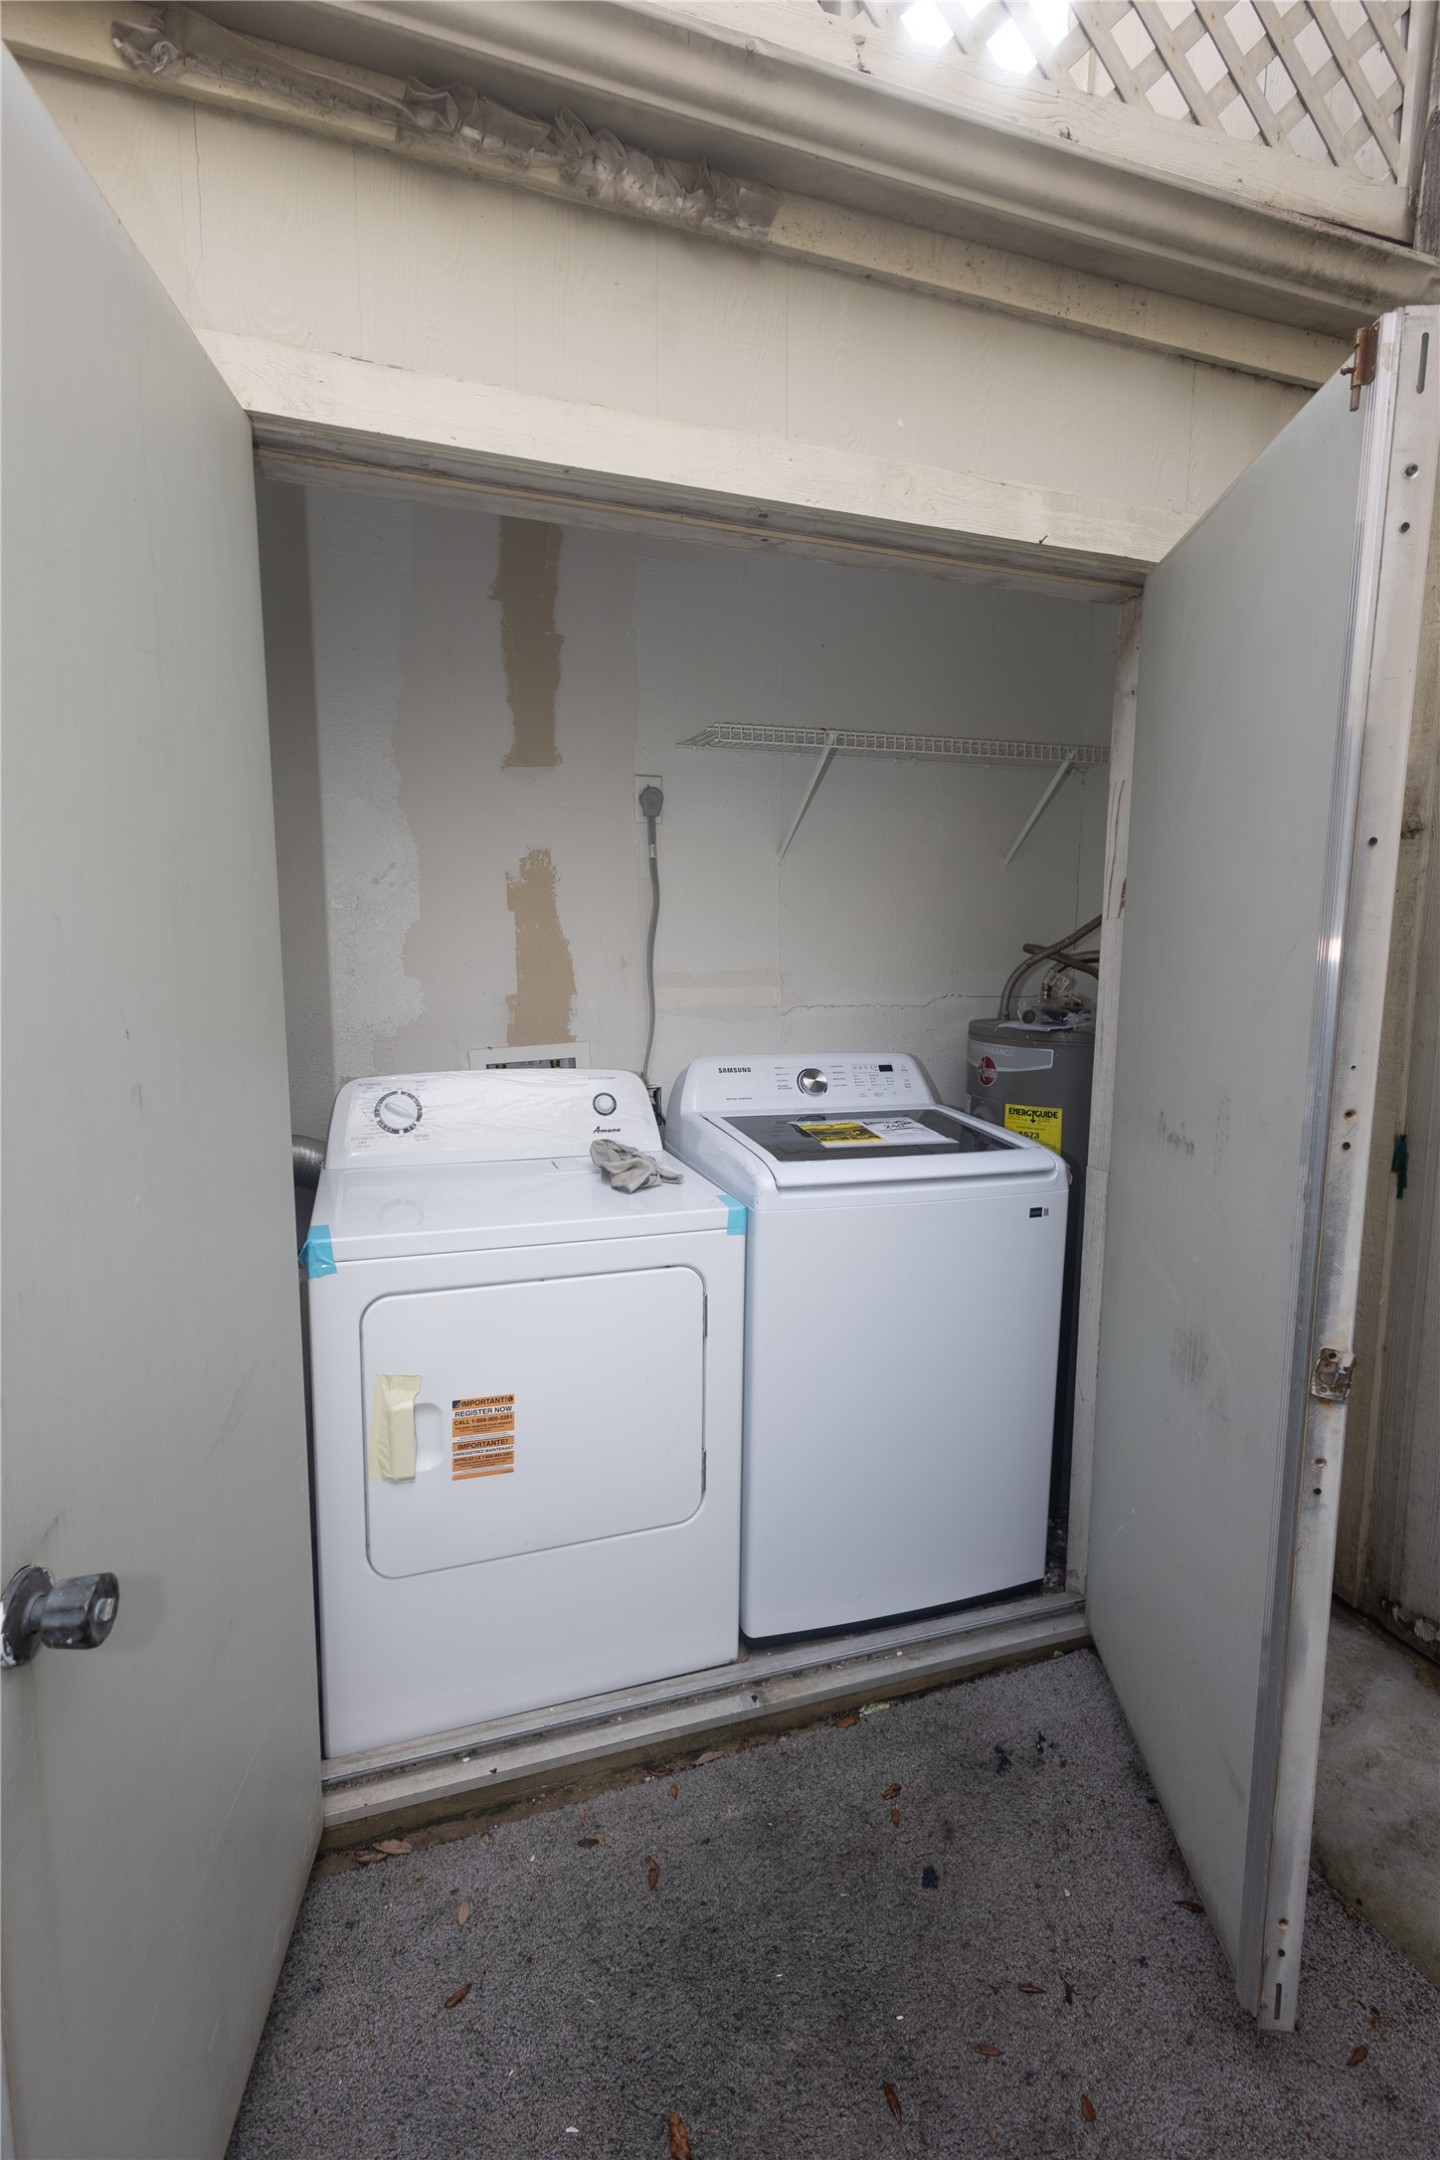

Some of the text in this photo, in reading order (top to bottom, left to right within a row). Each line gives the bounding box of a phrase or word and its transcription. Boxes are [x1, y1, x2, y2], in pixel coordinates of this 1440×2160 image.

[1008, 1107, 1058, 1119] ENERGYGUIDE
[593, 1126, 621, 1134] Amana
[455, 1405, 512, 1417] REGISTER NOW
[453, 1449, 484, 1457] ENREGISTREZ
